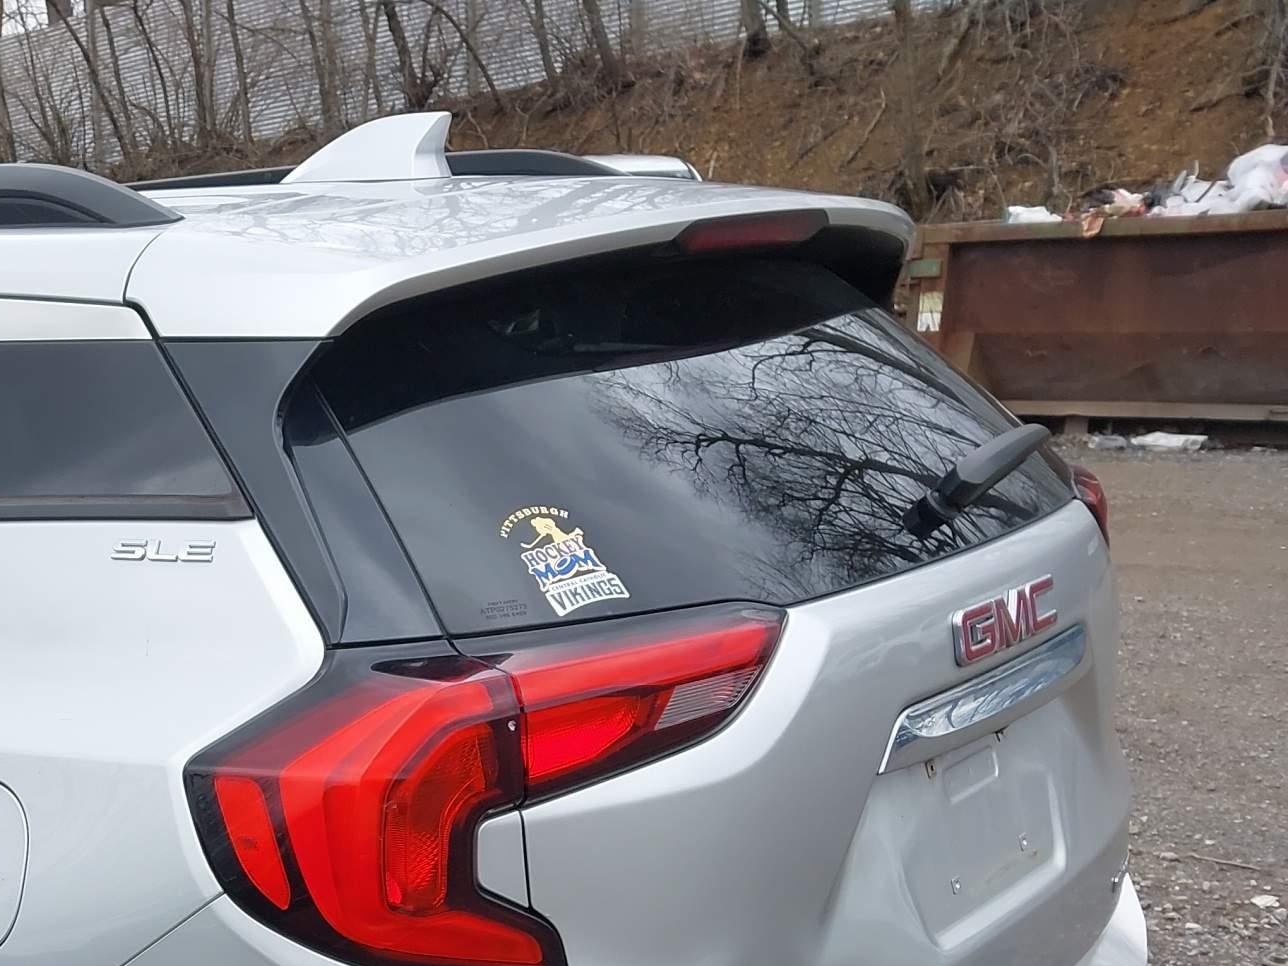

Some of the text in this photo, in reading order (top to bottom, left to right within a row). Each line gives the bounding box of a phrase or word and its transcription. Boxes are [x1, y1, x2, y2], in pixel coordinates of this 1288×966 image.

[499, 506, 569, 538] PITTSBURGH
[110, 538, 216, 563] SLE
[524, 536, 584, 567] HOCKEY
[531, 549, 599, 588] MOM
[550, 577, 626, 611] VIKINGS
[951, 573, 1058, 667] GMC
